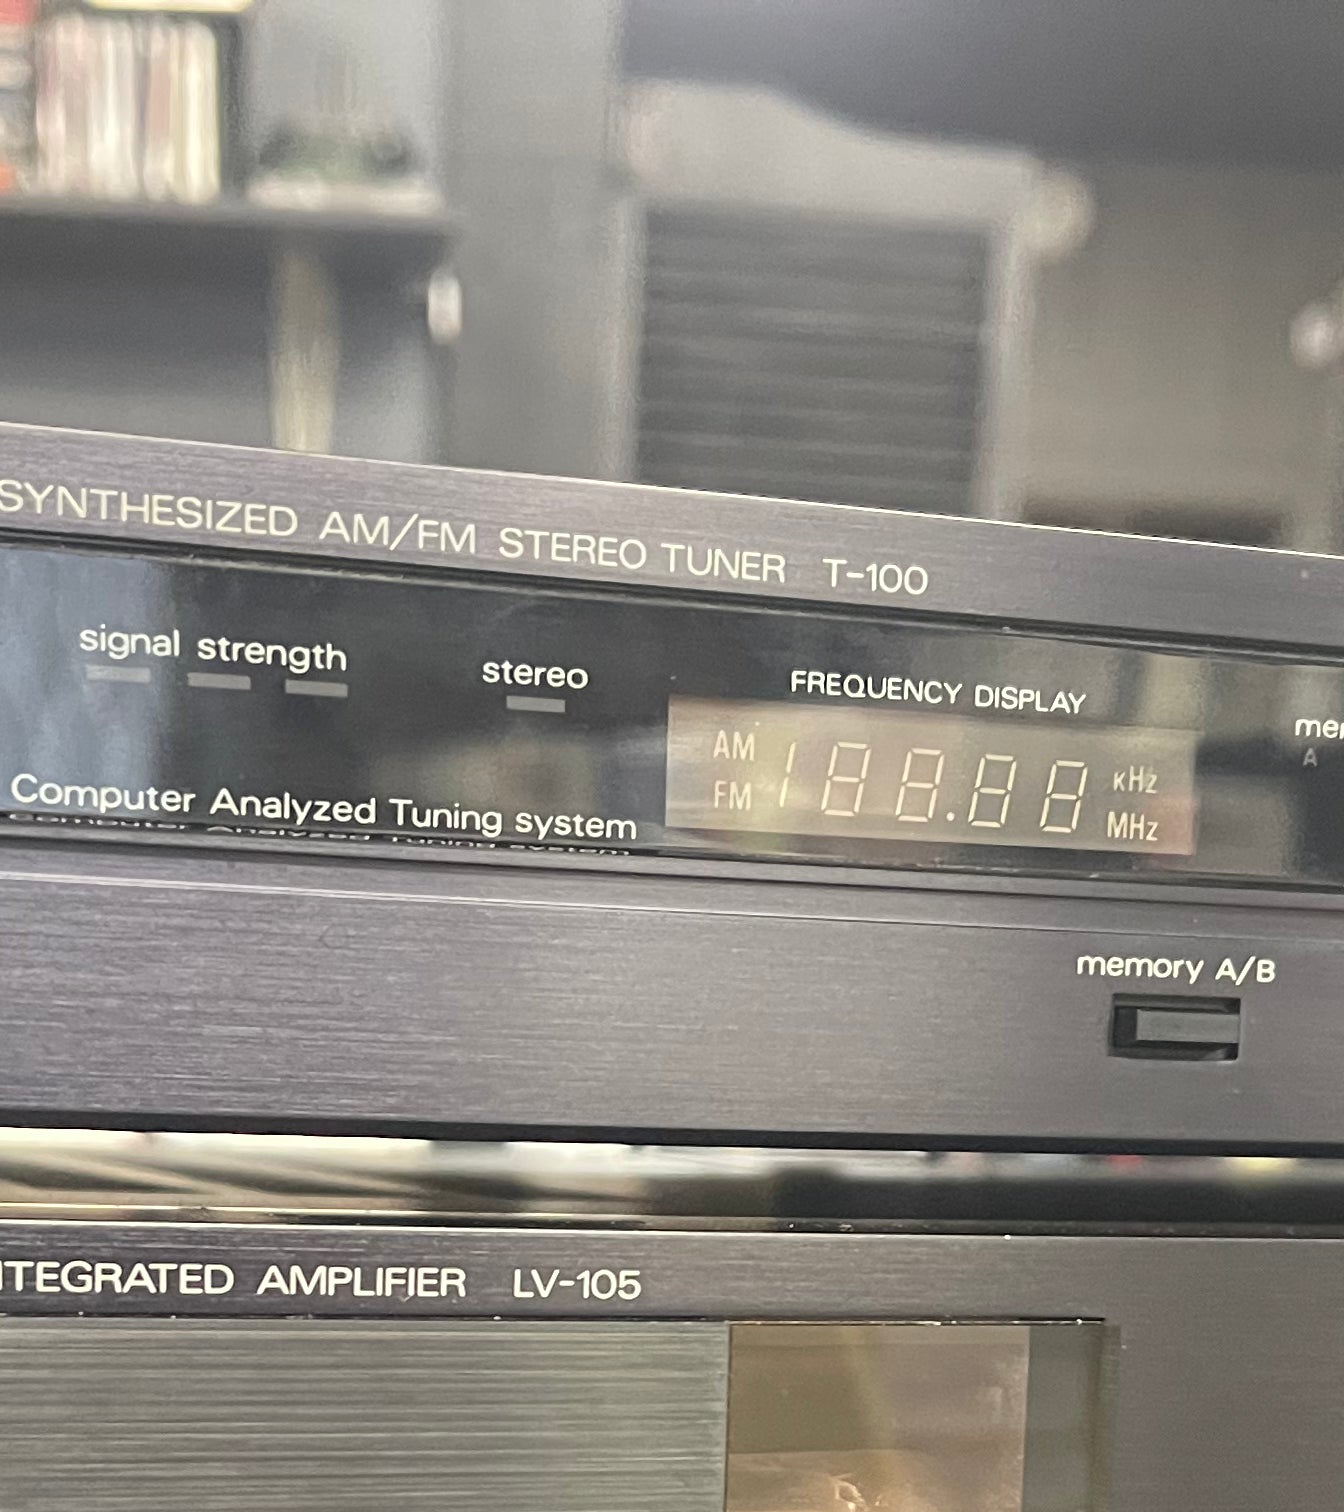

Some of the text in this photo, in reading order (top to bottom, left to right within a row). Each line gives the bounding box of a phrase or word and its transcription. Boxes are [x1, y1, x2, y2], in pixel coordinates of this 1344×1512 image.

[320, 512, 476, 555] AM/FM
[498, 526, 647, 570] STEREO
[660, 542, 786, 583] TUNER
[823, 557, 929, 595] T-100
[79, 624, 348, 674] signal strength
[481, 657, 589, 689] stereo
[790, 669, 1087, 714] FREQUENCY DISPLAY
[712, 730, 755, 762] AM
[10, 773, 196, 815] Computer
[209, 787, 377, 827] Analyzed
[388, 799, 503, 837] Tuning
[514, 813, 638, 841] system
[713, 781, 752, 811] FM
[1106, 811, 1159, 842] MHz
[1076, 952, 1276, 985] memory A/B
[256, 1265, 467, 1299] AMPLIFIER
[512, 1268, 643, 1302] LV-105
